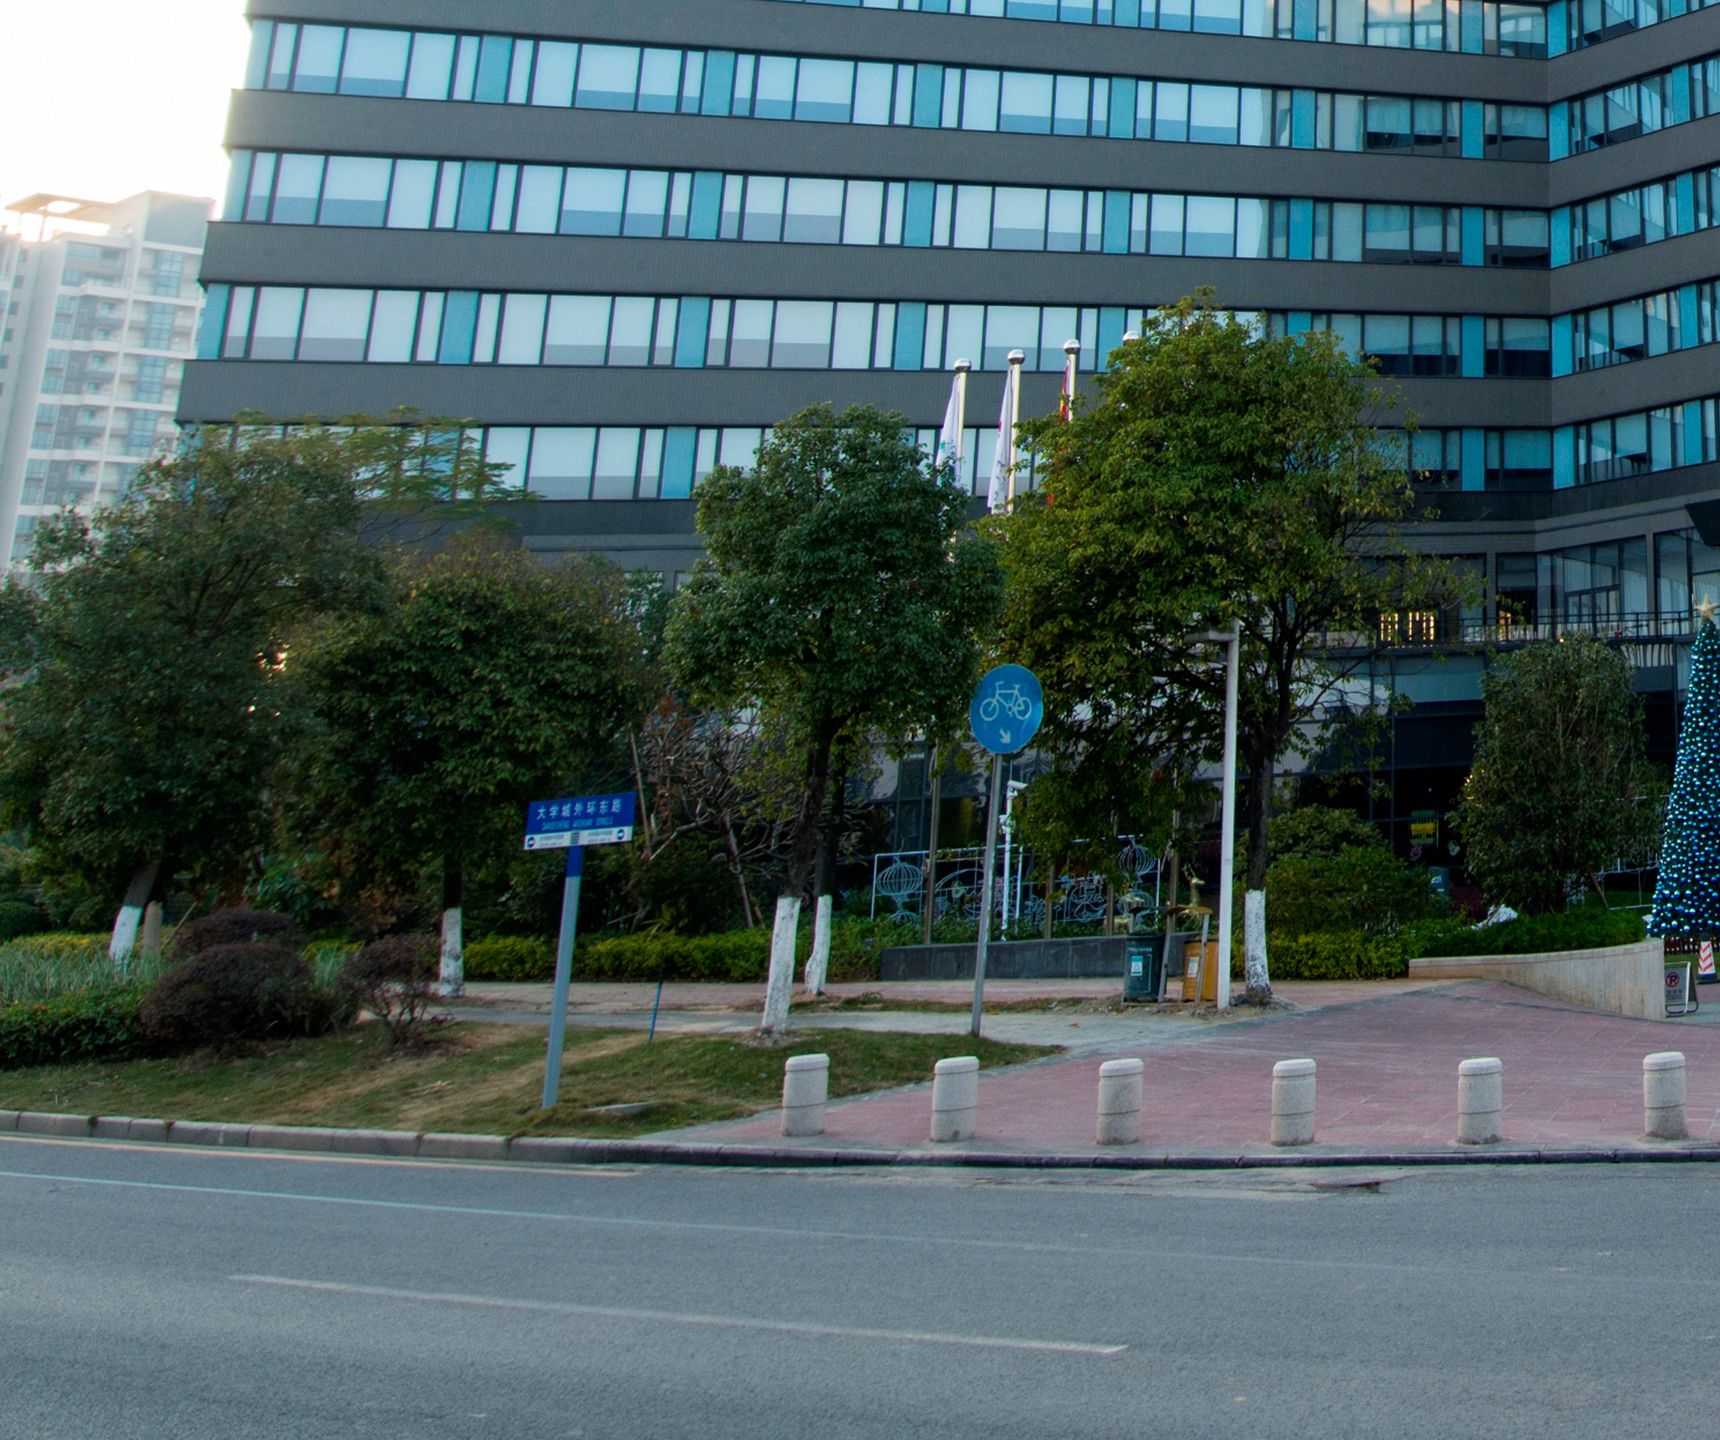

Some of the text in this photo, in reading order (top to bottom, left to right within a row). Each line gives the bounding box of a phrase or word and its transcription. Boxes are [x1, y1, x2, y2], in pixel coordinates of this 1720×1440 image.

[536, 798, 622, 820] 大学城外环东路
